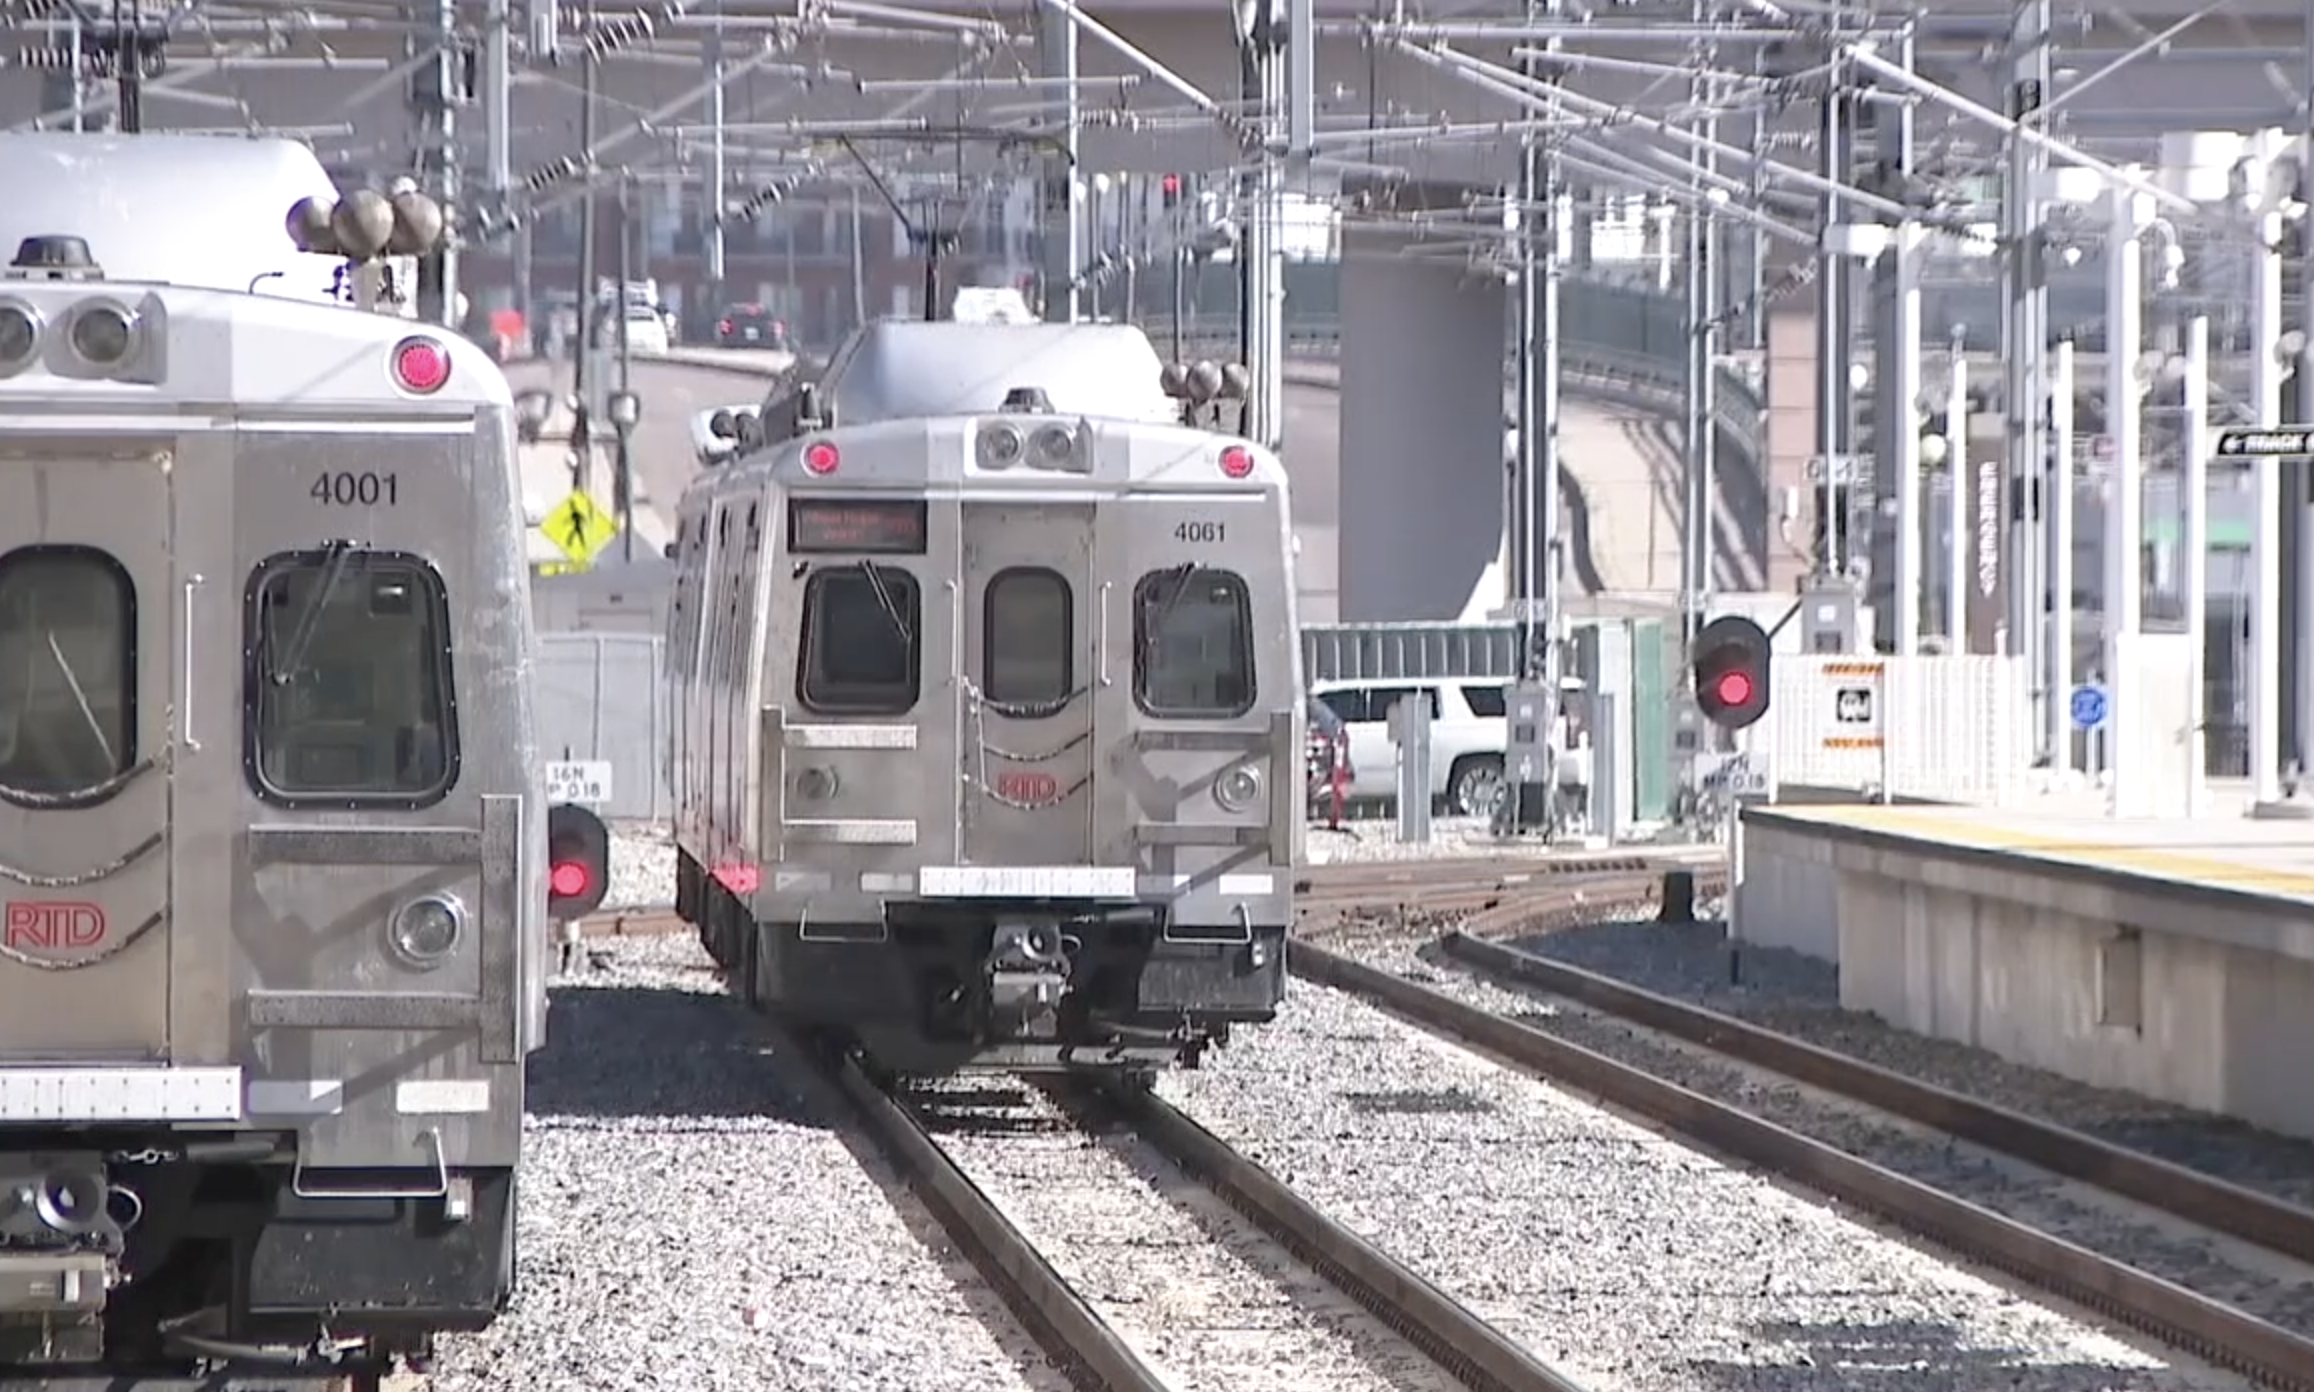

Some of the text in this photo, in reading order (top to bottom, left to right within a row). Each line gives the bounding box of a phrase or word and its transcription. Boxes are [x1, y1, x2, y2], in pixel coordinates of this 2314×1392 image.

[311, 472, 396, 505] 4001
[1174, 521, 1225, 542] 4061
[5, 902, 105, 947] RTD
